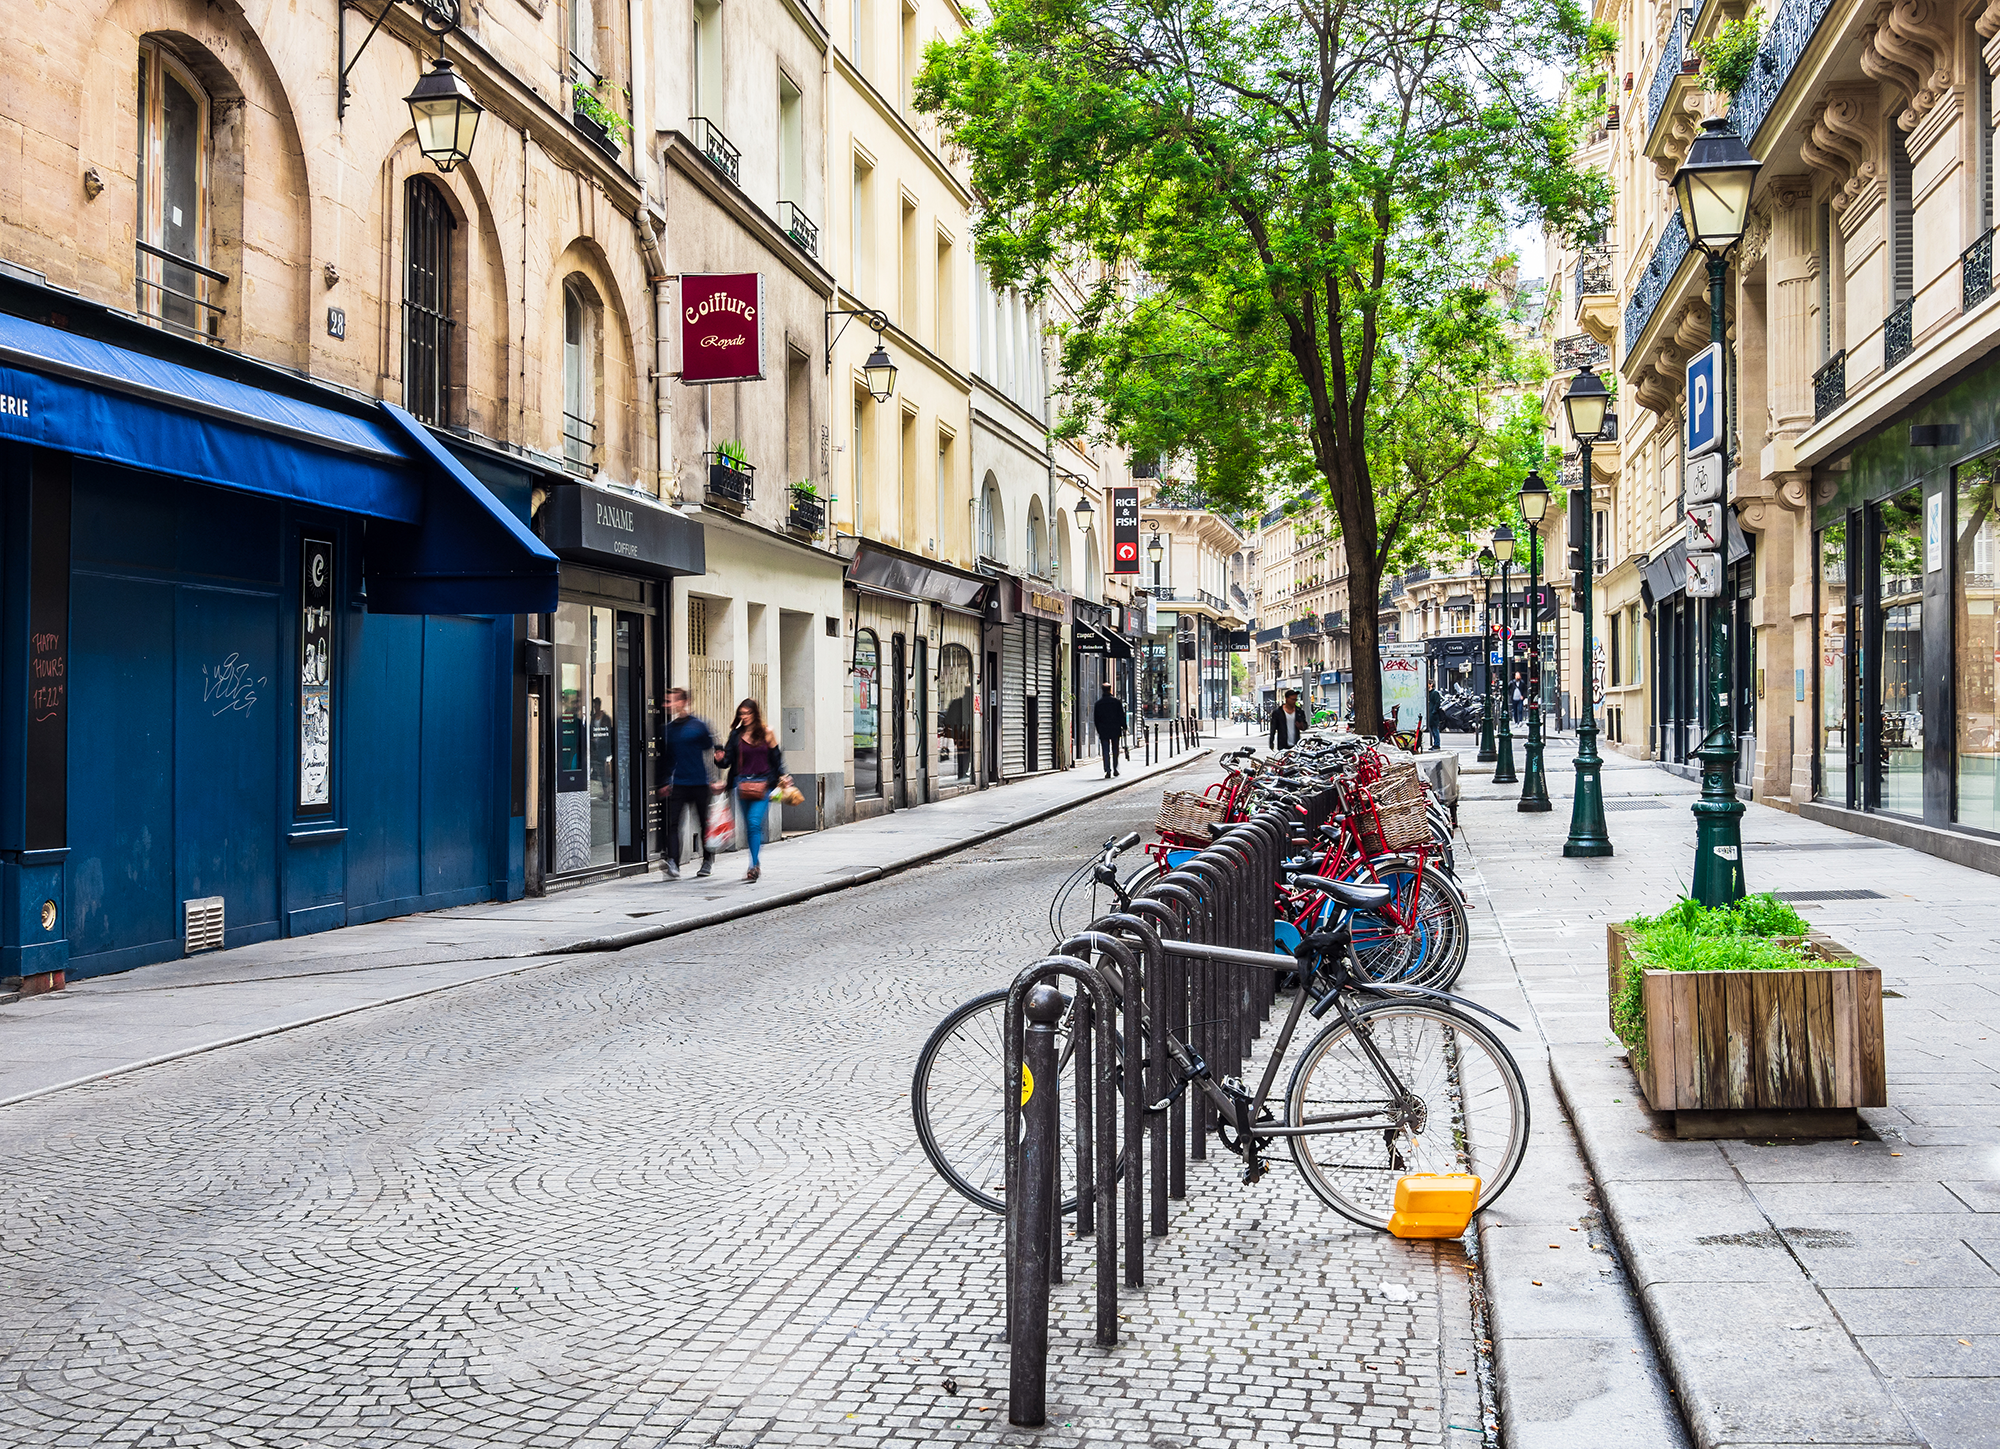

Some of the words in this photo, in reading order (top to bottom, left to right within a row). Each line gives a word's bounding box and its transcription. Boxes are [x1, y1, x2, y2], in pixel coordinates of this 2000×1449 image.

[685, 292, 756, 325] Coiffure
[330, 310, 344, 336] 28
[700, 334, 746, 350] Royale
[1694, 373, 1708, 434] P
[1115, 498, 1137, 507] RICE
[1122, 508, 1130, 516] &
[596, 503, 634, 532] PANAME
[1115, 517, 1137, 527] FISH
[613, 541, 638, 557] COIFFURE
[32, 633, 59, 654] HAPPY
[33, 656, 64, 678] HOURS
